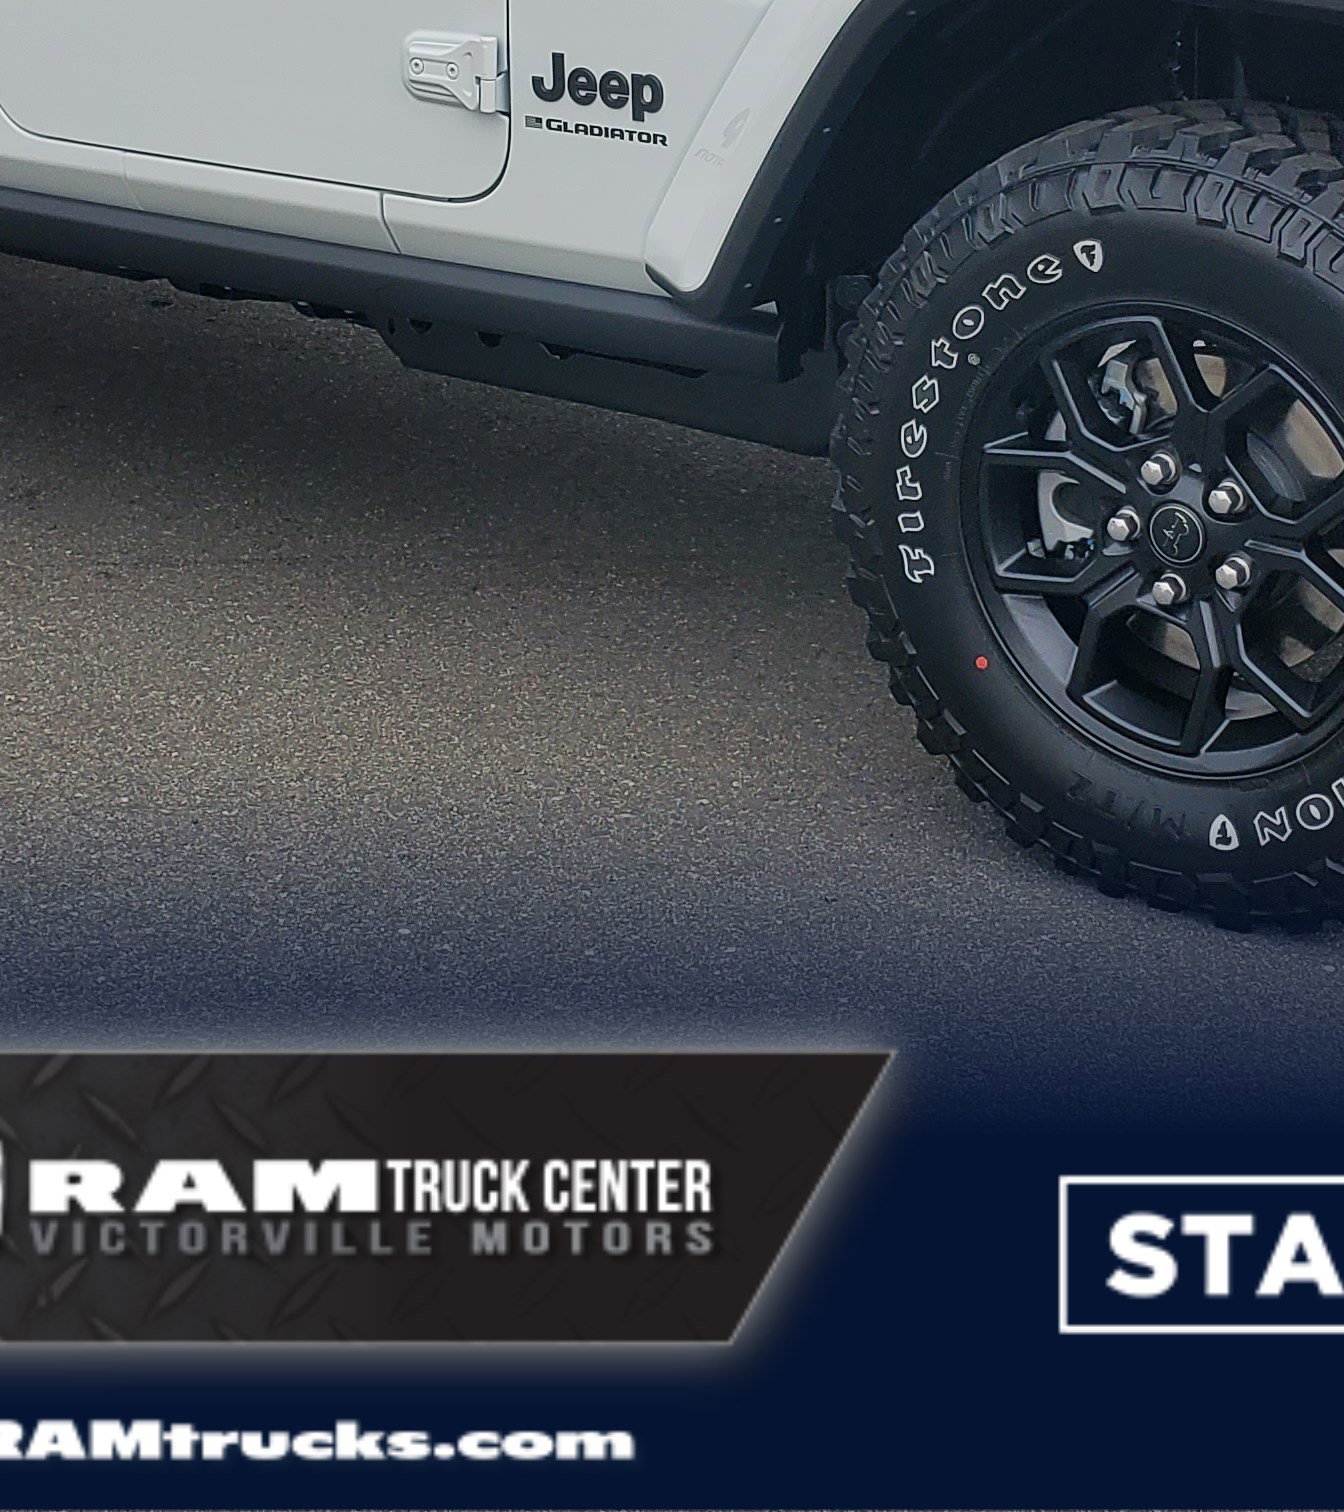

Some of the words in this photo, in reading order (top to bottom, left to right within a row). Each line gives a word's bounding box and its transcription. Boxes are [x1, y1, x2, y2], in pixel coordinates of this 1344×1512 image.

[531, 52, 664, 123] Jeep
[545, 118, 669, 147] GLADIATOR
[896, 253, 1064, 584] Firestone
